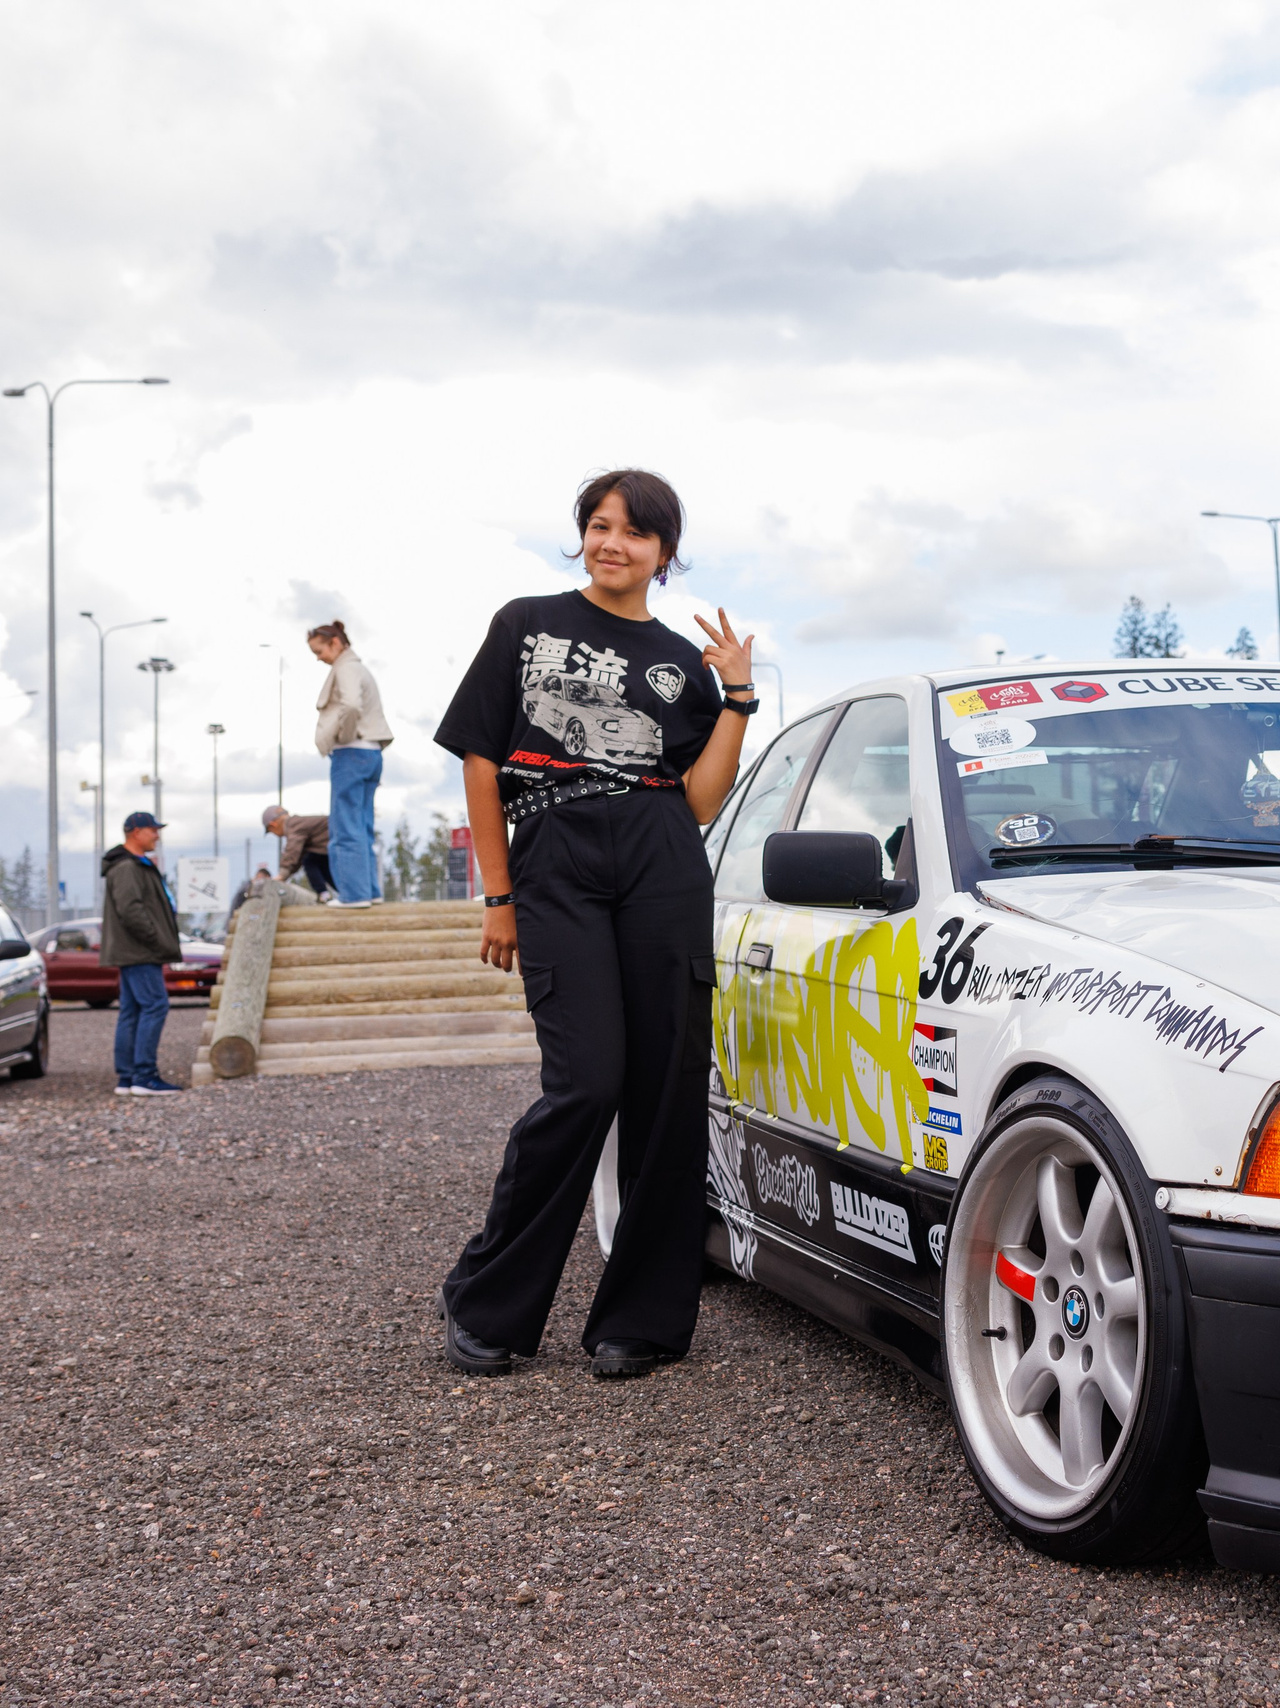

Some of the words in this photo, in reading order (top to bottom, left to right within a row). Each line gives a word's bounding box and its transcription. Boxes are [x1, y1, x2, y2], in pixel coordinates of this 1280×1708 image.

[1118, 677, 1234, 695] CUBE
[617, 772, 639, 783] PRO
[1008, 817, 1039, 829] 30
[918, 916, 993, 1005] 36
[1039, 967, 1163, 1018] MOTORSPORT
[1143, 991, 1265, 1073] COMMANDOS
[914, 1045, 955, 1074] CHAMPION
[1034, 1089, 1061, 1102] P609
[926, 1110, 959, 1129] ICHELIN
[923, 1133, 948, 1160] MS
[925, 1155, 949, 1173] GROUP
[830, 1181, 909, 1250] BULLDOZER
